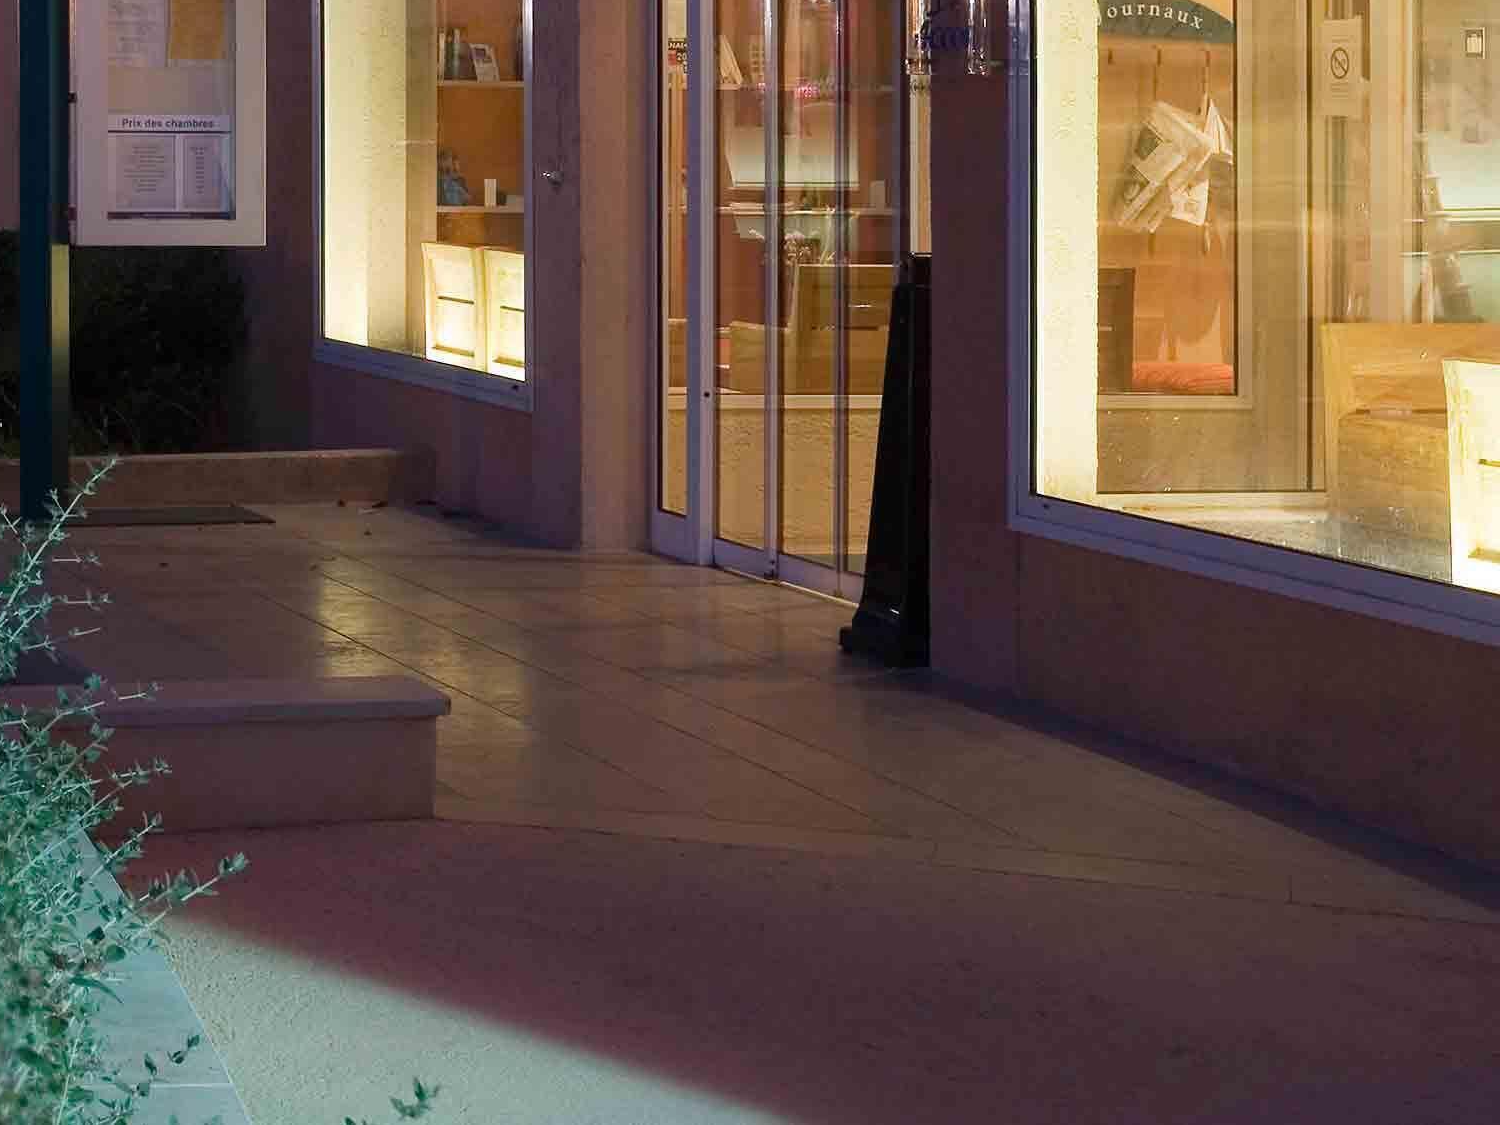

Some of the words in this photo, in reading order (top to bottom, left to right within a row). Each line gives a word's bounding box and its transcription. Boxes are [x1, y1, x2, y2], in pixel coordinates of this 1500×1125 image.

[122, 118, 142, 128] Prix
[145, 118, 163, 128] des
[165, 117, 214, 129] chambres
